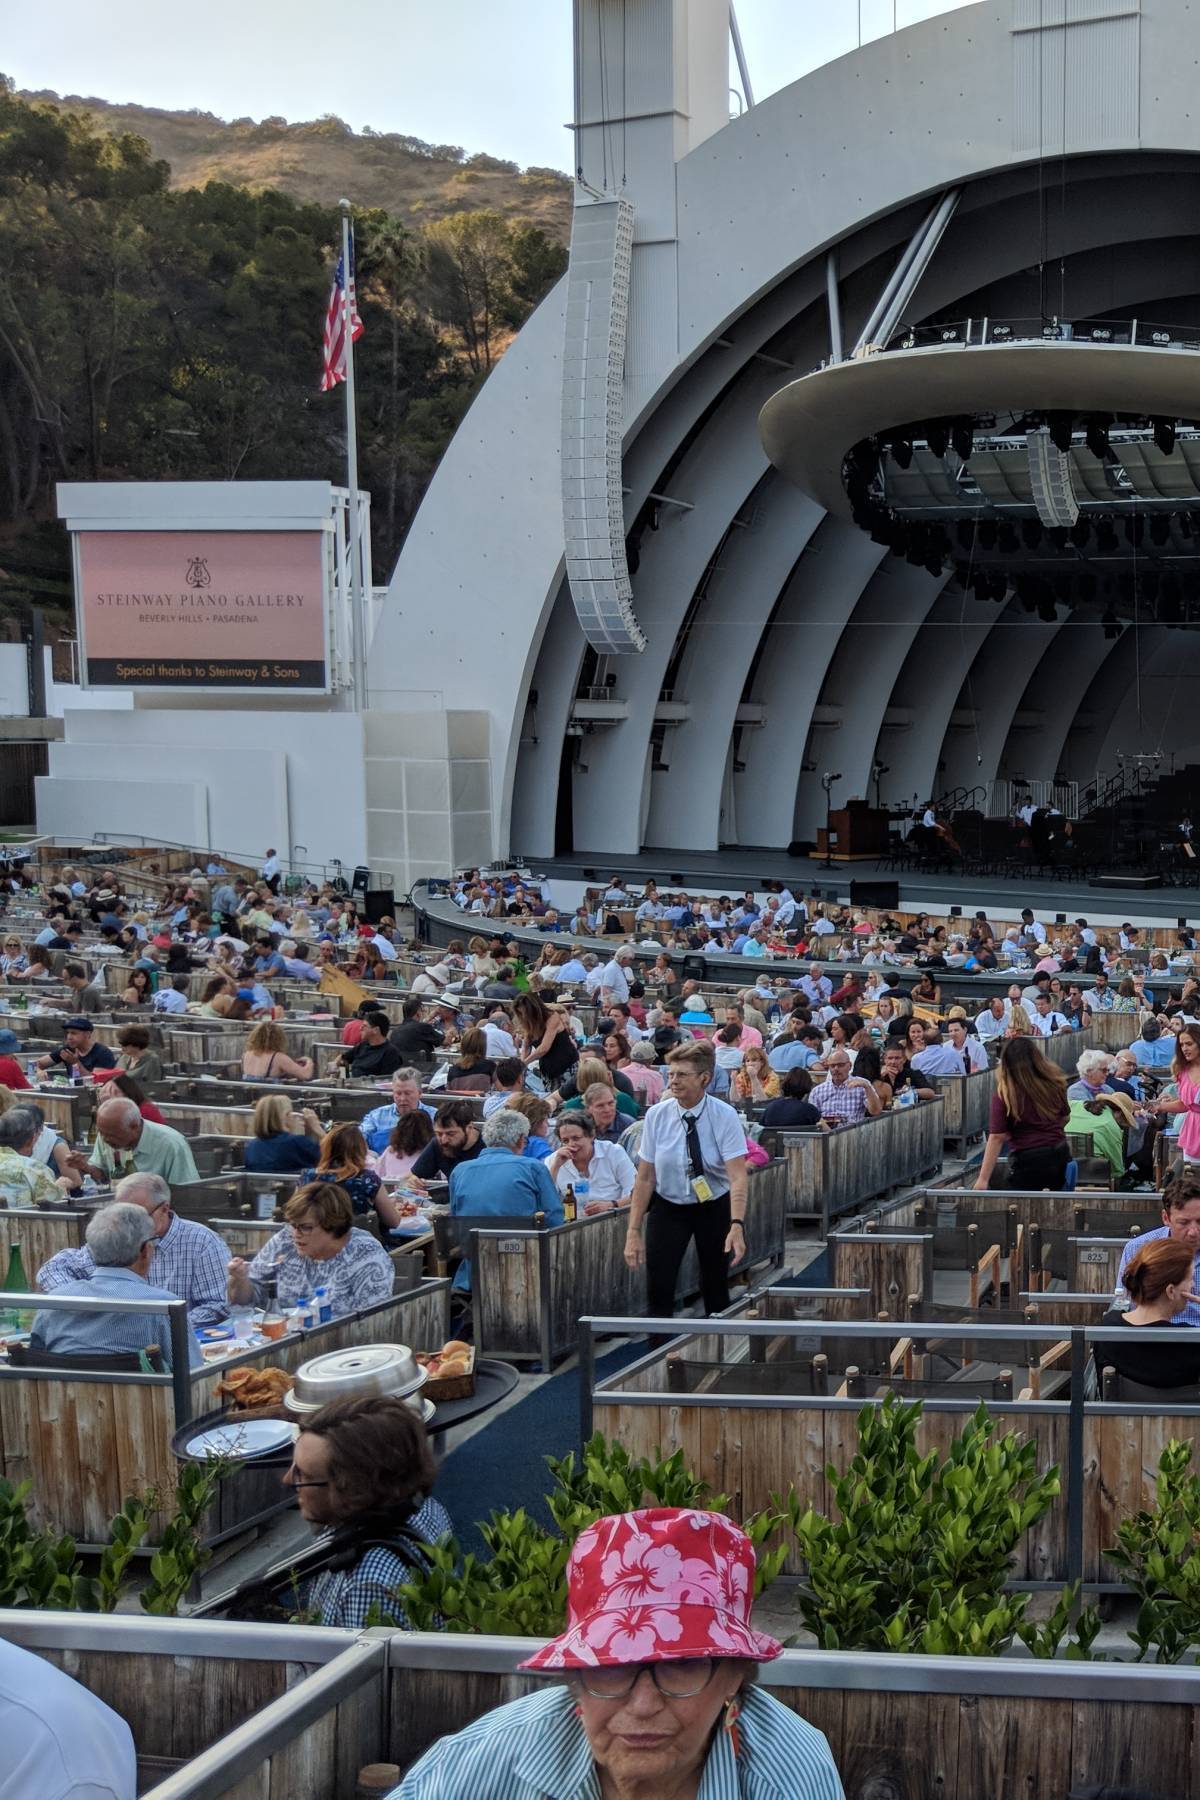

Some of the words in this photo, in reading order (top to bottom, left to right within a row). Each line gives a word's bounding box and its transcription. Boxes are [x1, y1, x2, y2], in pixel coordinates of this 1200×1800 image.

[97, 594, 174, 607] STEINWAY
[181, 594, 228, 607] PIANO
[235, 595, 305, 607] GALLERY
[139, 614, 176, 623] BEVERLY
[179, 614, 203, 623] HILLS
[212, 614, 259, 623] PASADENA
[116, 664, 156, 679] Special
[158, 664, 192, 677] thanks
[195, 665, 206, 677] to
[208, 664, 258, 680] Steinway
[260, 665, 271, 677] &
[273, 665, 300, 678] Sons
[1087, 1253, 1103, 1261] 825
